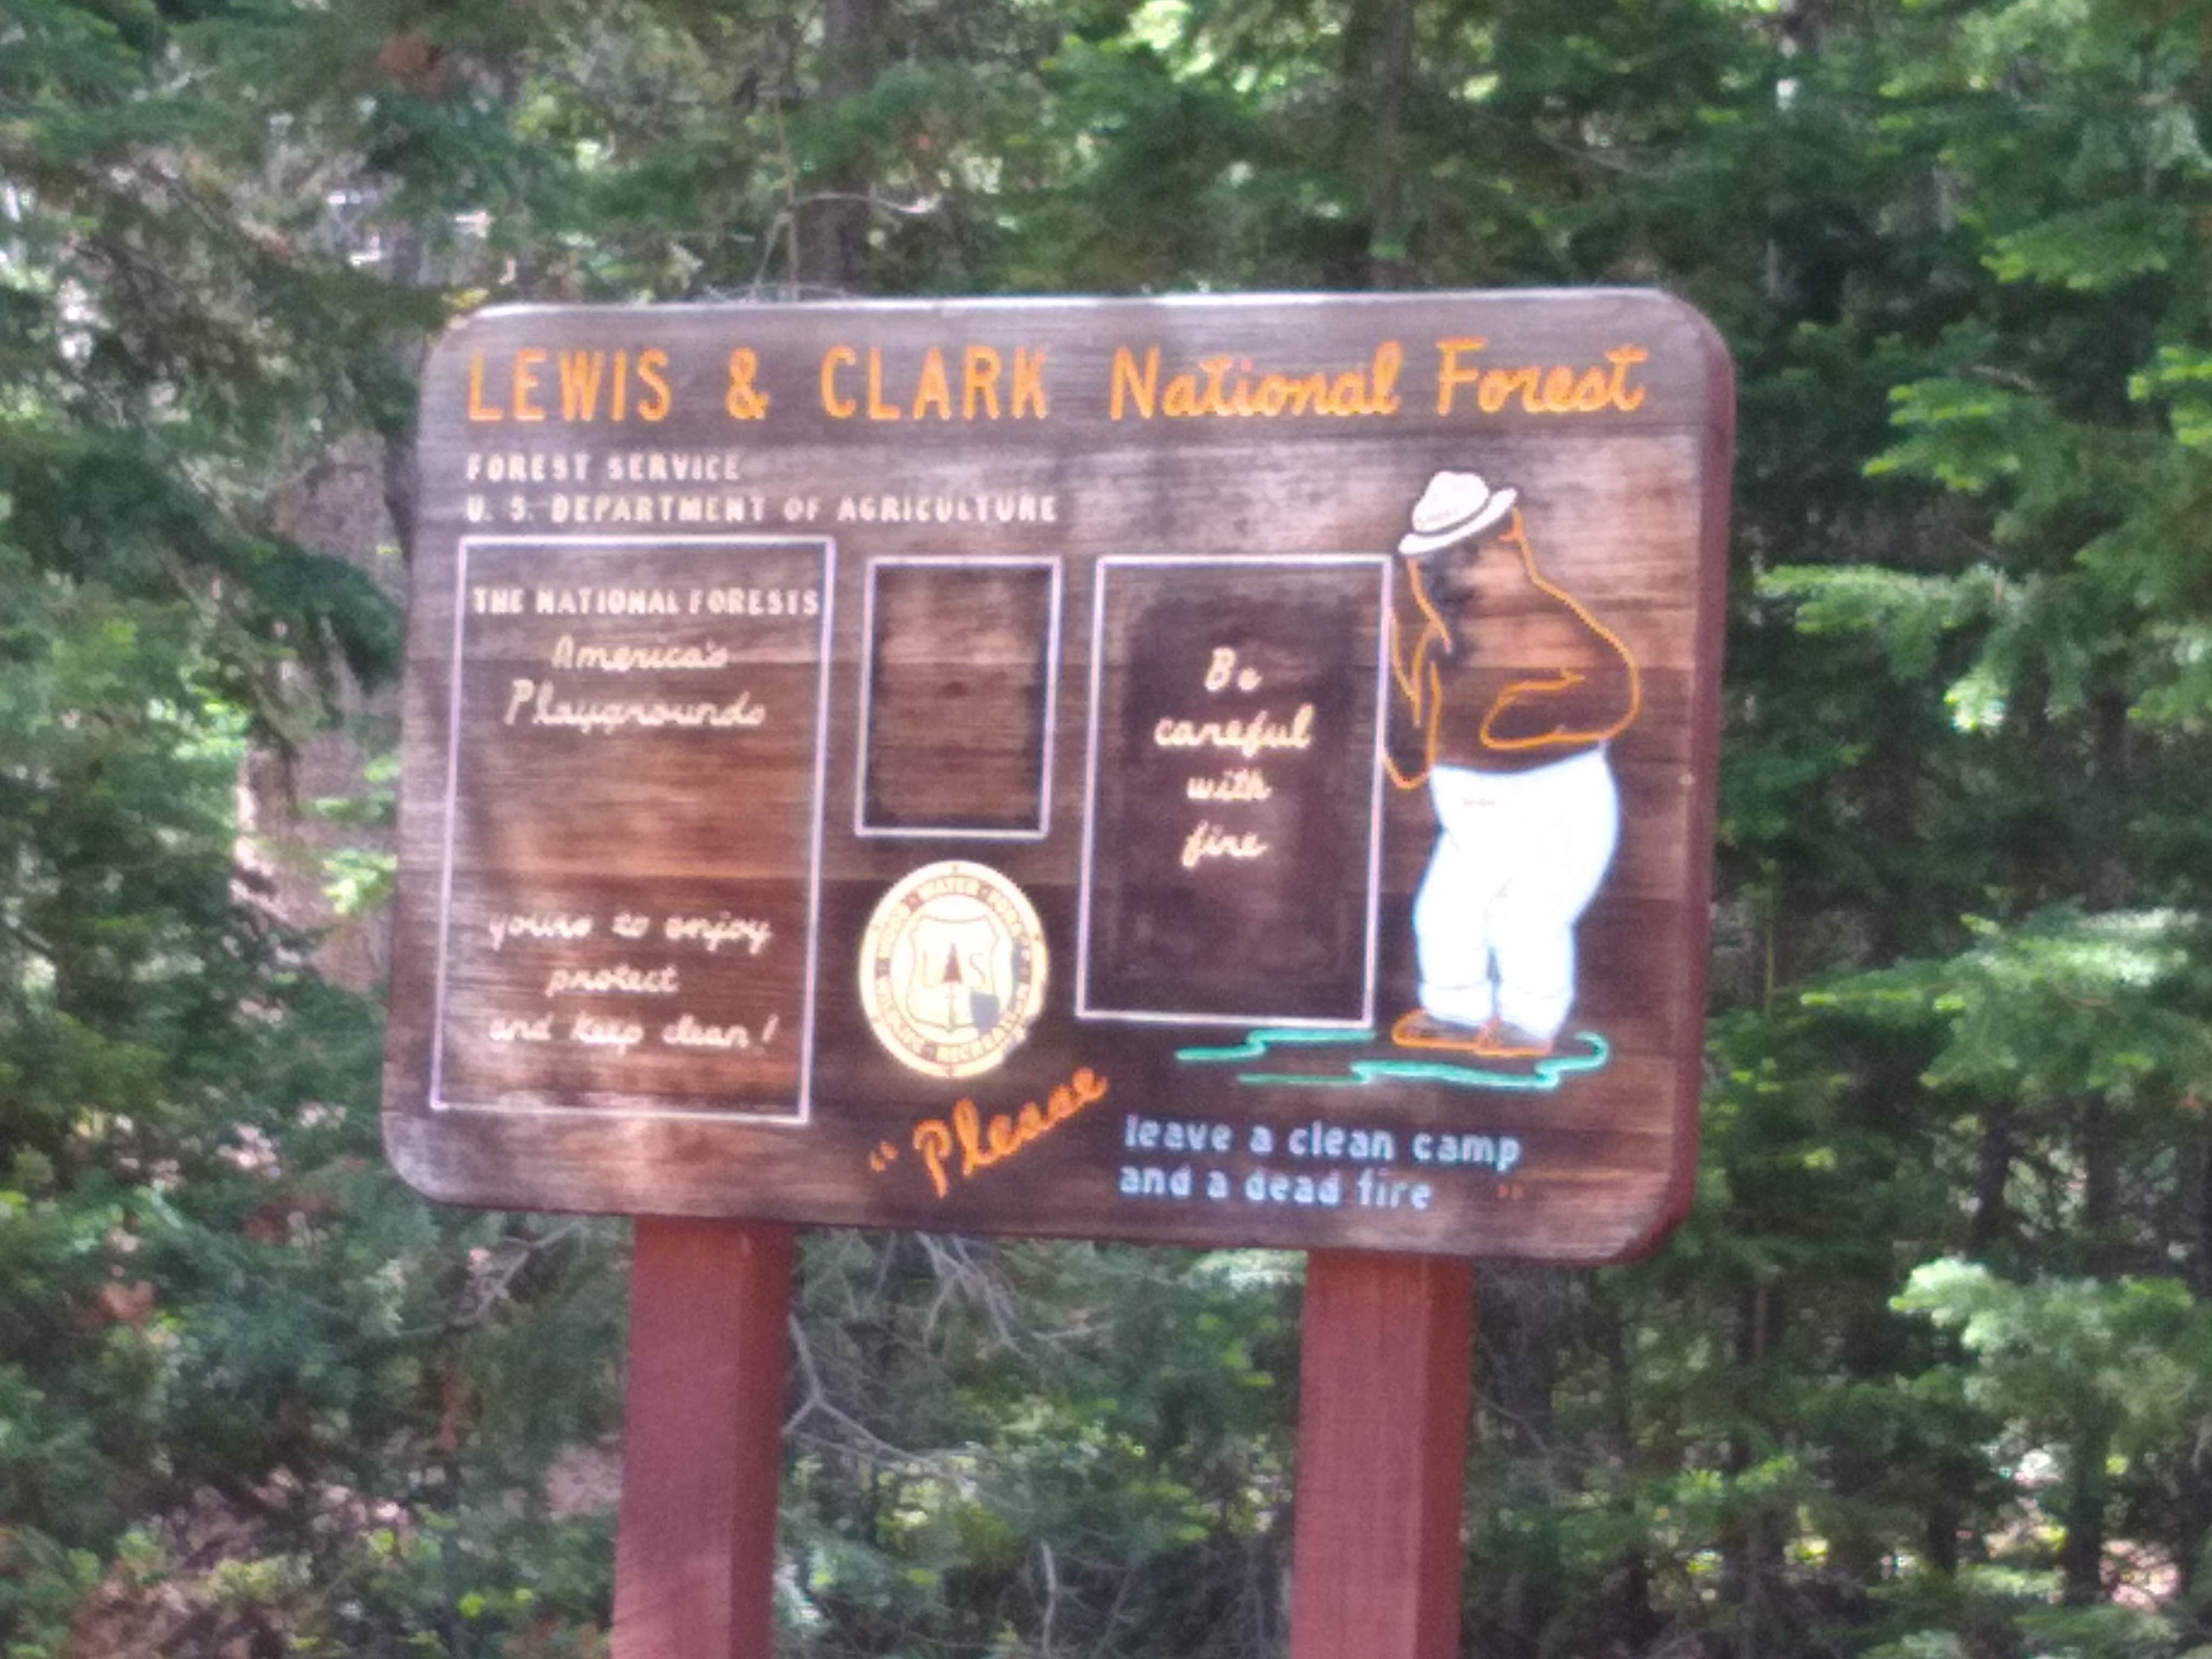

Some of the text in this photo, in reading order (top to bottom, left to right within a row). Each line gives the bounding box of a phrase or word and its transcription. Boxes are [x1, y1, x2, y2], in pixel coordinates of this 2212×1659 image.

[464, 336, 1648, 421] LEWIS & CLARK National Forest
[466, 454, 740, 481] FOREST SERVICE
[550, 495, 765, 523] DEPARTMENT
[783, 495, 822, 523] OF
[838, 495, 1057, 523] AGRICULTURE
[473, 588, 819, 615] THE NATIONAL FORESTS
[551, 635, 729, 671] America's
[1204, 647, 1262, 690] Be
[504, 678, 765, 733] Playgrounds
[1154, 703, 1314, 757] careful
[1187, 769, 1272, 800] with
[1182, 820, 1269, 867] fire
[611, 911, 649, 938] to
[665, 911, 773, 954] enjoy
[545, 964, 679, 997] protect
[490, 1011, 553, 1041] and
[571, 1012, 645, 1056] keep
[1124, 1114, 1522, 1172] leave a clean camp
[1120, 1164, 1191, 1196] and
[1207, 1171, 1230, 1199] a
[1245, 1170, 1341, 1205] dead
[1357, 1169, 1433, 1210] fire
